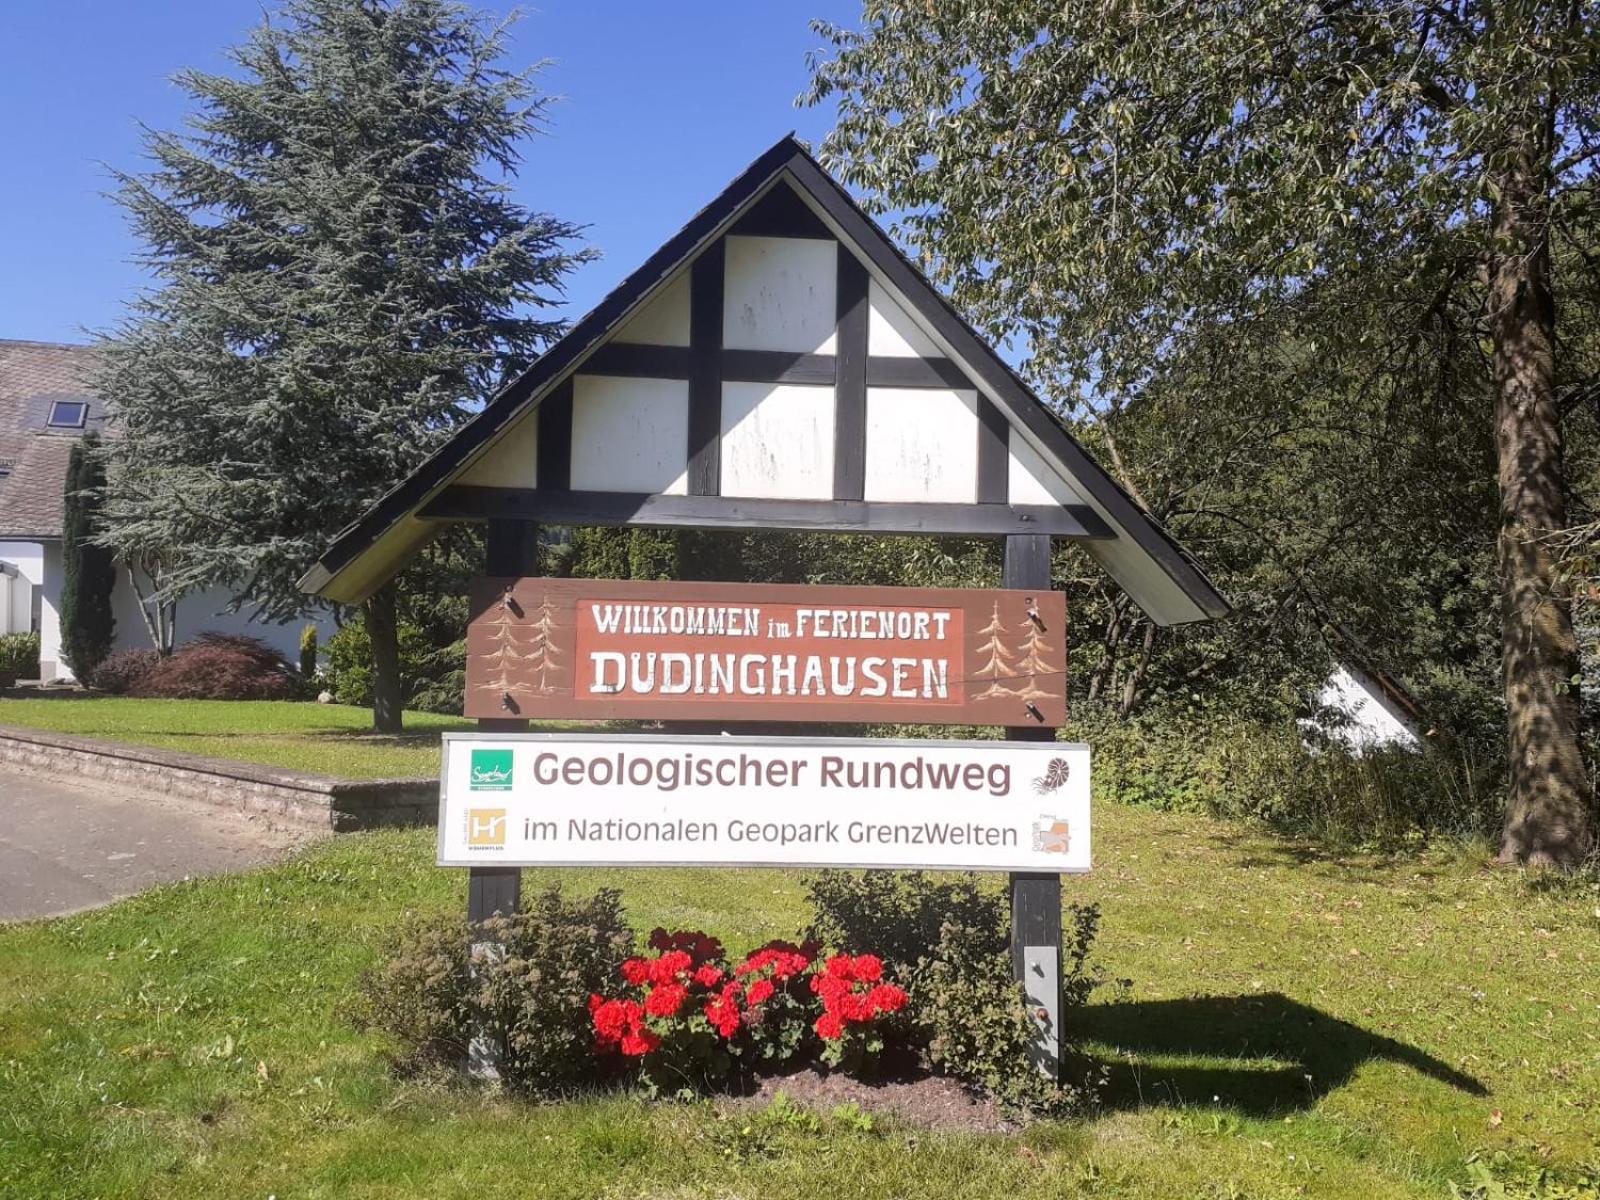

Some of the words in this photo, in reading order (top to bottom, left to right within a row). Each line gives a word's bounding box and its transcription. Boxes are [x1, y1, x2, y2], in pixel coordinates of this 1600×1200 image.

[591, 604, 761, 637] WILLKOMMEN
[767, 618, 792, 639] im
[796, 609, 951, 640] FERIENORT
[533, 752, 808, 792] Geologischer
[820, 756, 1011, 797] Rundweg
[524, 817, 558, 841] im
[568, 818, 718, 842] Nationalen
[727, 819, 839, 846] Geopark
[847, 821, 1018, 846] GrenzWelten
